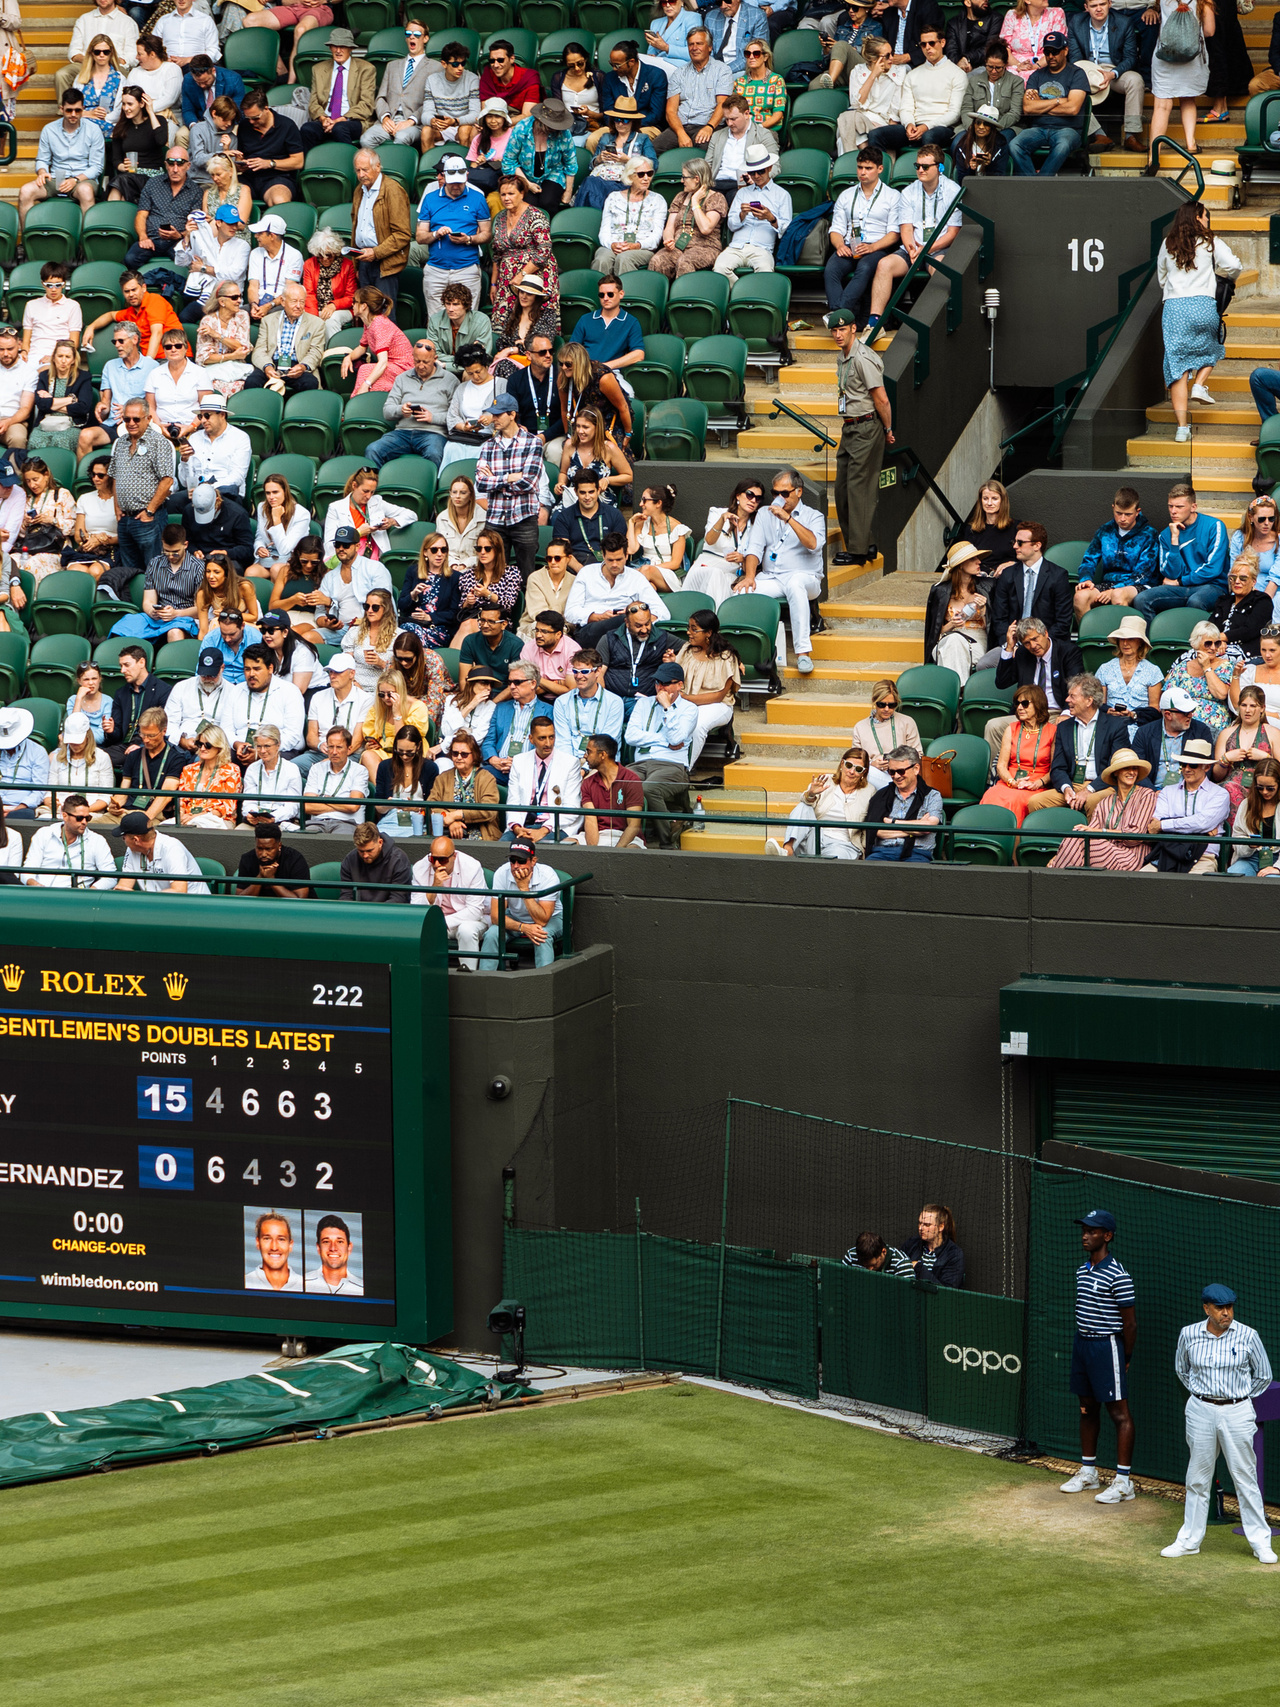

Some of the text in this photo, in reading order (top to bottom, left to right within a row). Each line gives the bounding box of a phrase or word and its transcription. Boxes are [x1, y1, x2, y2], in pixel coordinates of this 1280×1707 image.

[1067, 238, 1105, 273] 16
[39, 970, 148, 997] ROLEX
[312, 983, 363, 1008] 2:22
[146, 1024, 249, 1048] DOUBLES
[255, 1030, 335, 1053] LATEST
[141, 1050, 187, 1065] POINTS
[210, 1054, 218, 1066] 1
[246, 1056, 255, 1068] 2
[282, 1058, 291, 1070] 3
[317, 1060, 327, 1072] 4
[354, 1062, 363, 1074] 5
[143, 1083, 187, 1114] 15
[205, 1087, 225, 1114] 4
[241, 1087, 260, 1117] 6
[277, 1090, 296, 1119] 6
[313, 1091, 333, 1121] 3
[154, 1152, 178, 1182] 0
[207, 1155, 226, 1184] 6
[242, 1158, 262, 1186] 4
[279, 1159, 297, 1188] 3
[315, 1161, 334, 1191] 2
[73, 1210, 124, 1235] 0:00
[51, 1238, 147, 1256] CHANGE-OVER
[40, 1272, 159, 1293] wimbledon.com
[943, 1343, 1022, 1375] oppo
